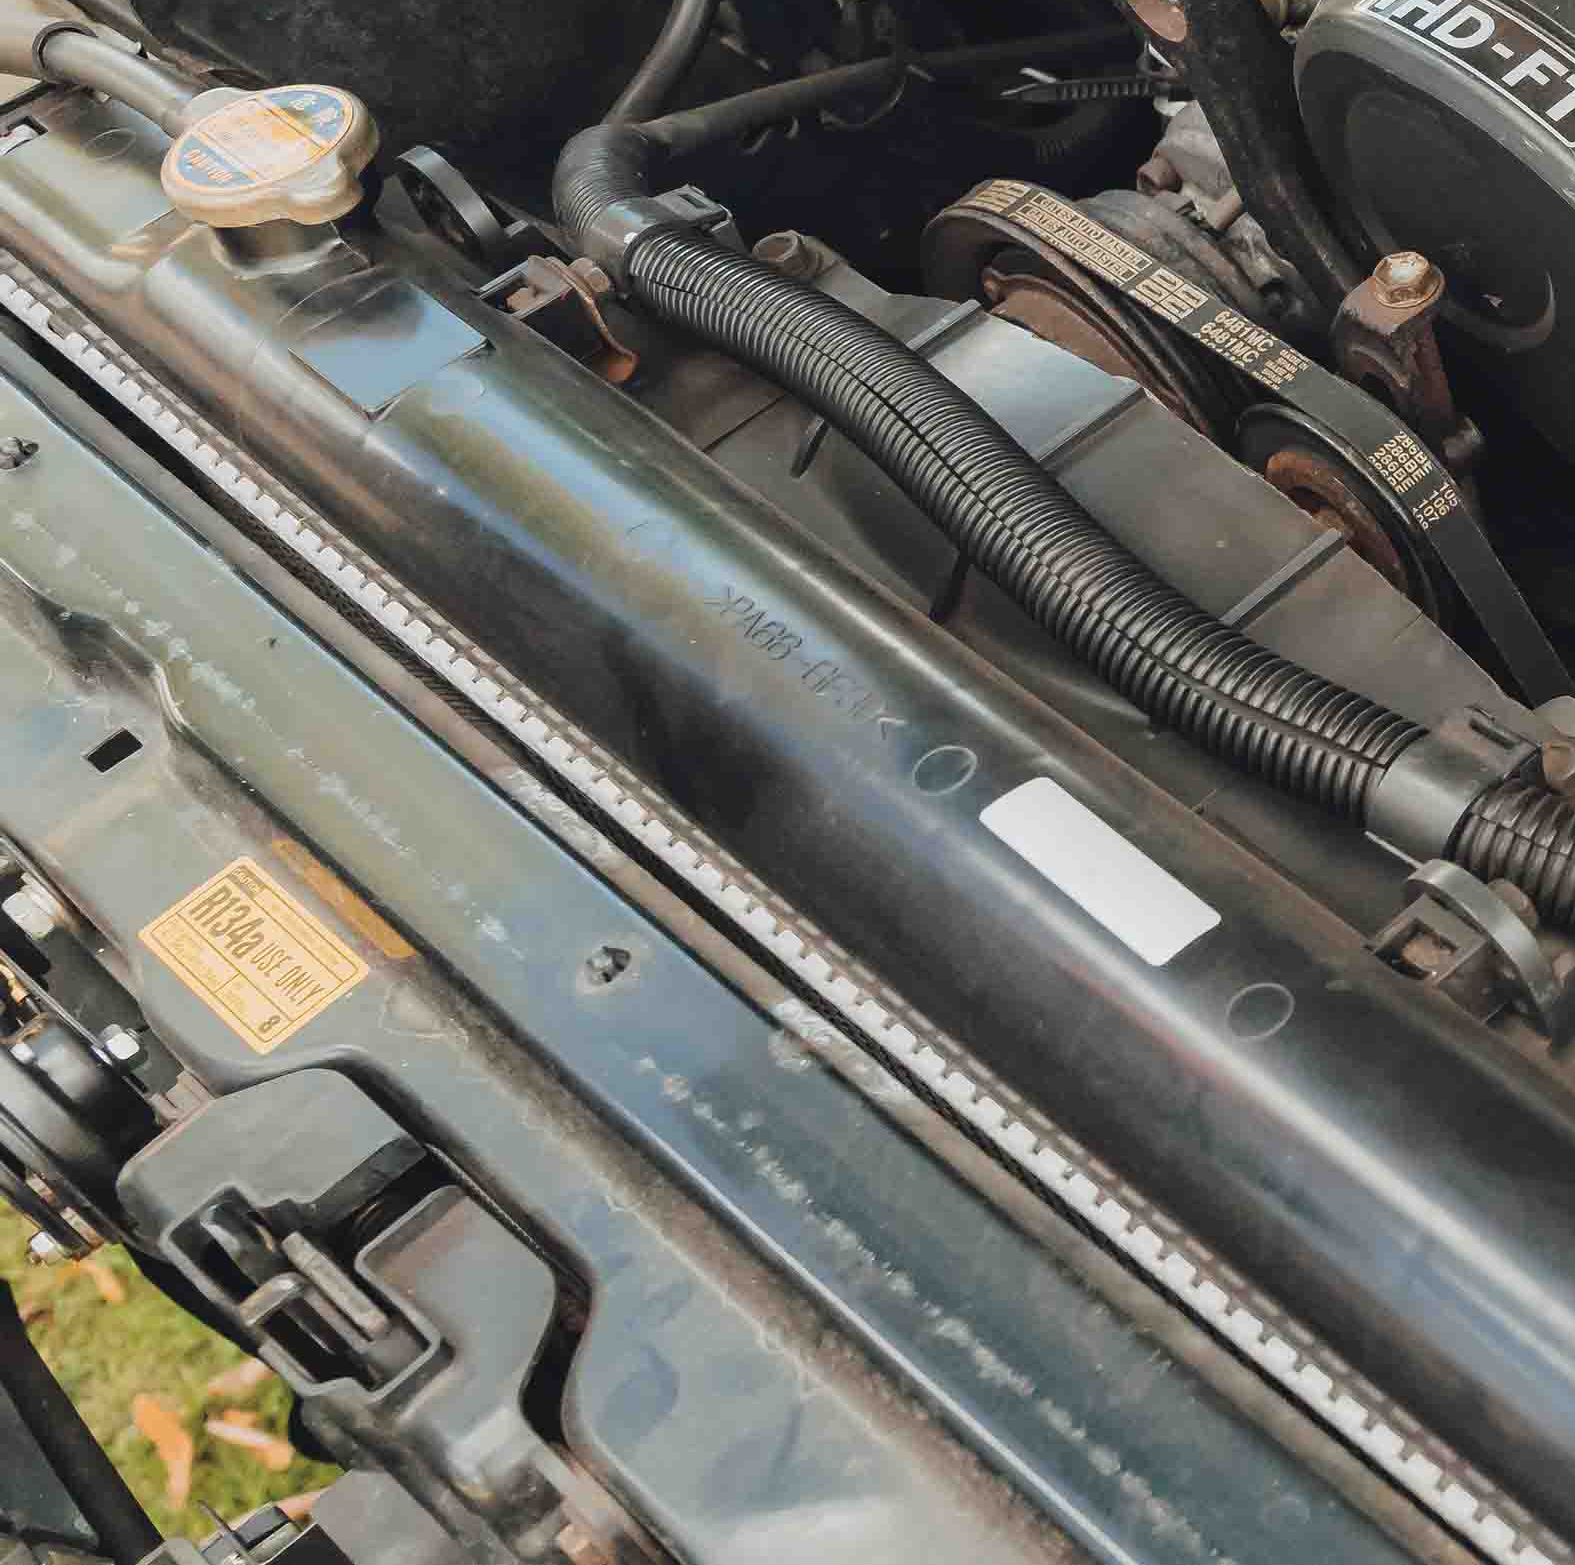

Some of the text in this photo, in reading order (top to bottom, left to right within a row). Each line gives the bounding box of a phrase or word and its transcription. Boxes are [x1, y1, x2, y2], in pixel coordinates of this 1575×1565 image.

[1024, 202, 1067, 237] GATES
[1061, 226, 1091, 252] AUTO
[1085, 242, 1130, 277] MASTER
[1037, 191, 1079, 225] GATES
[1073, 214, 1102, 239] AUTO
[1095, 229, 1145, 267] MASTER
[1196, 316, 1260, 366] 6481MC
[1211, 304, 1275, 354] 6481MC
[1374, 447, 1416, 489] 286BE
[1384, 439, 1425, 483] 286BE
[1394, 431, 1433, 474] 286BE
[1418, 499, 1440, 522] 107
[1429, 490, 1450, 516] 106
[189, 884, 265, 961] R134a
[250, 940, 289, 978] USE
[275, 964, 325, 1007] ONLY
[258, 1014, 281, 1034] 8
